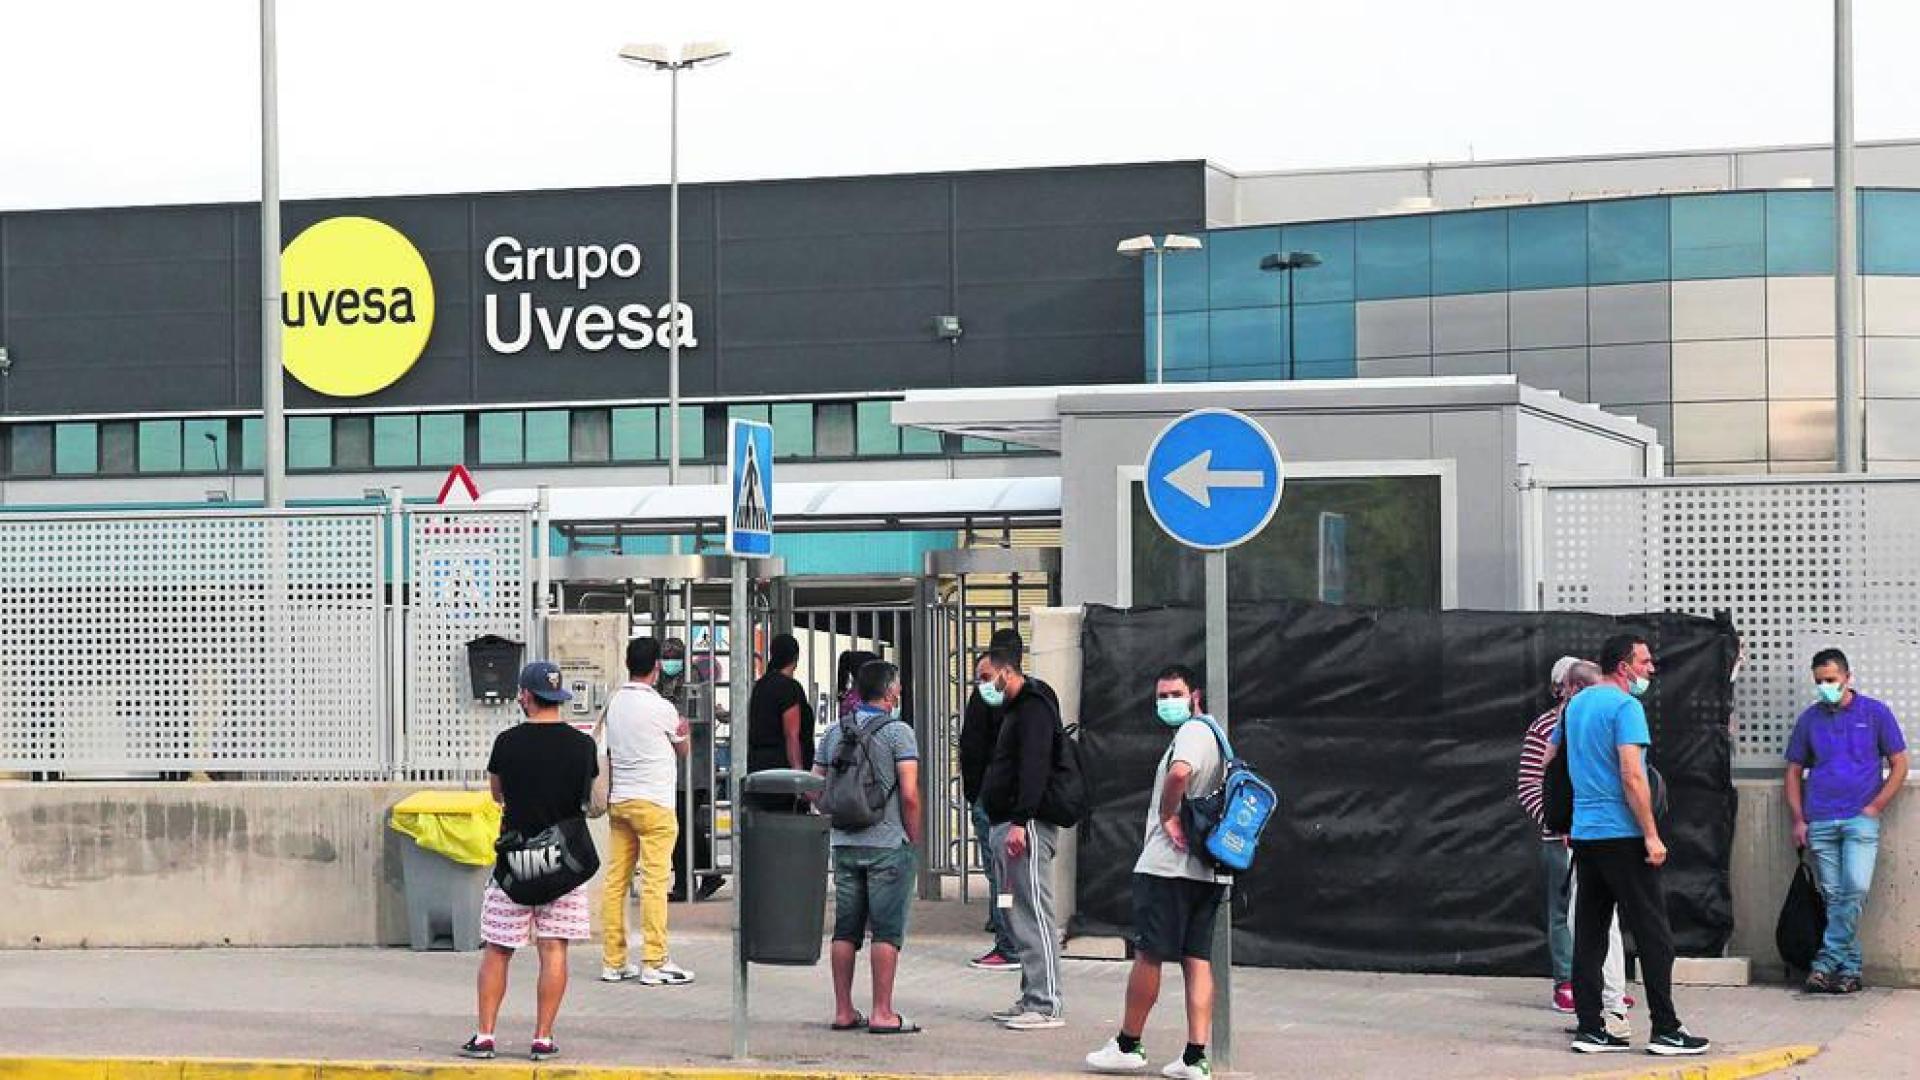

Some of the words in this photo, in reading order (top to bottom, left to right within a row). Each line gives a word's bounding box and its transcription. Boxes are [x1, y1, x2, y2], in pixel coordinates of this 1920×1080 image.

[485, 236, 642, 290] Grupo
[281, 286, 416, 328] uvesa
[485, 292, 698, 354] Uvesa
[507, 843, 562, 881] NIKE
